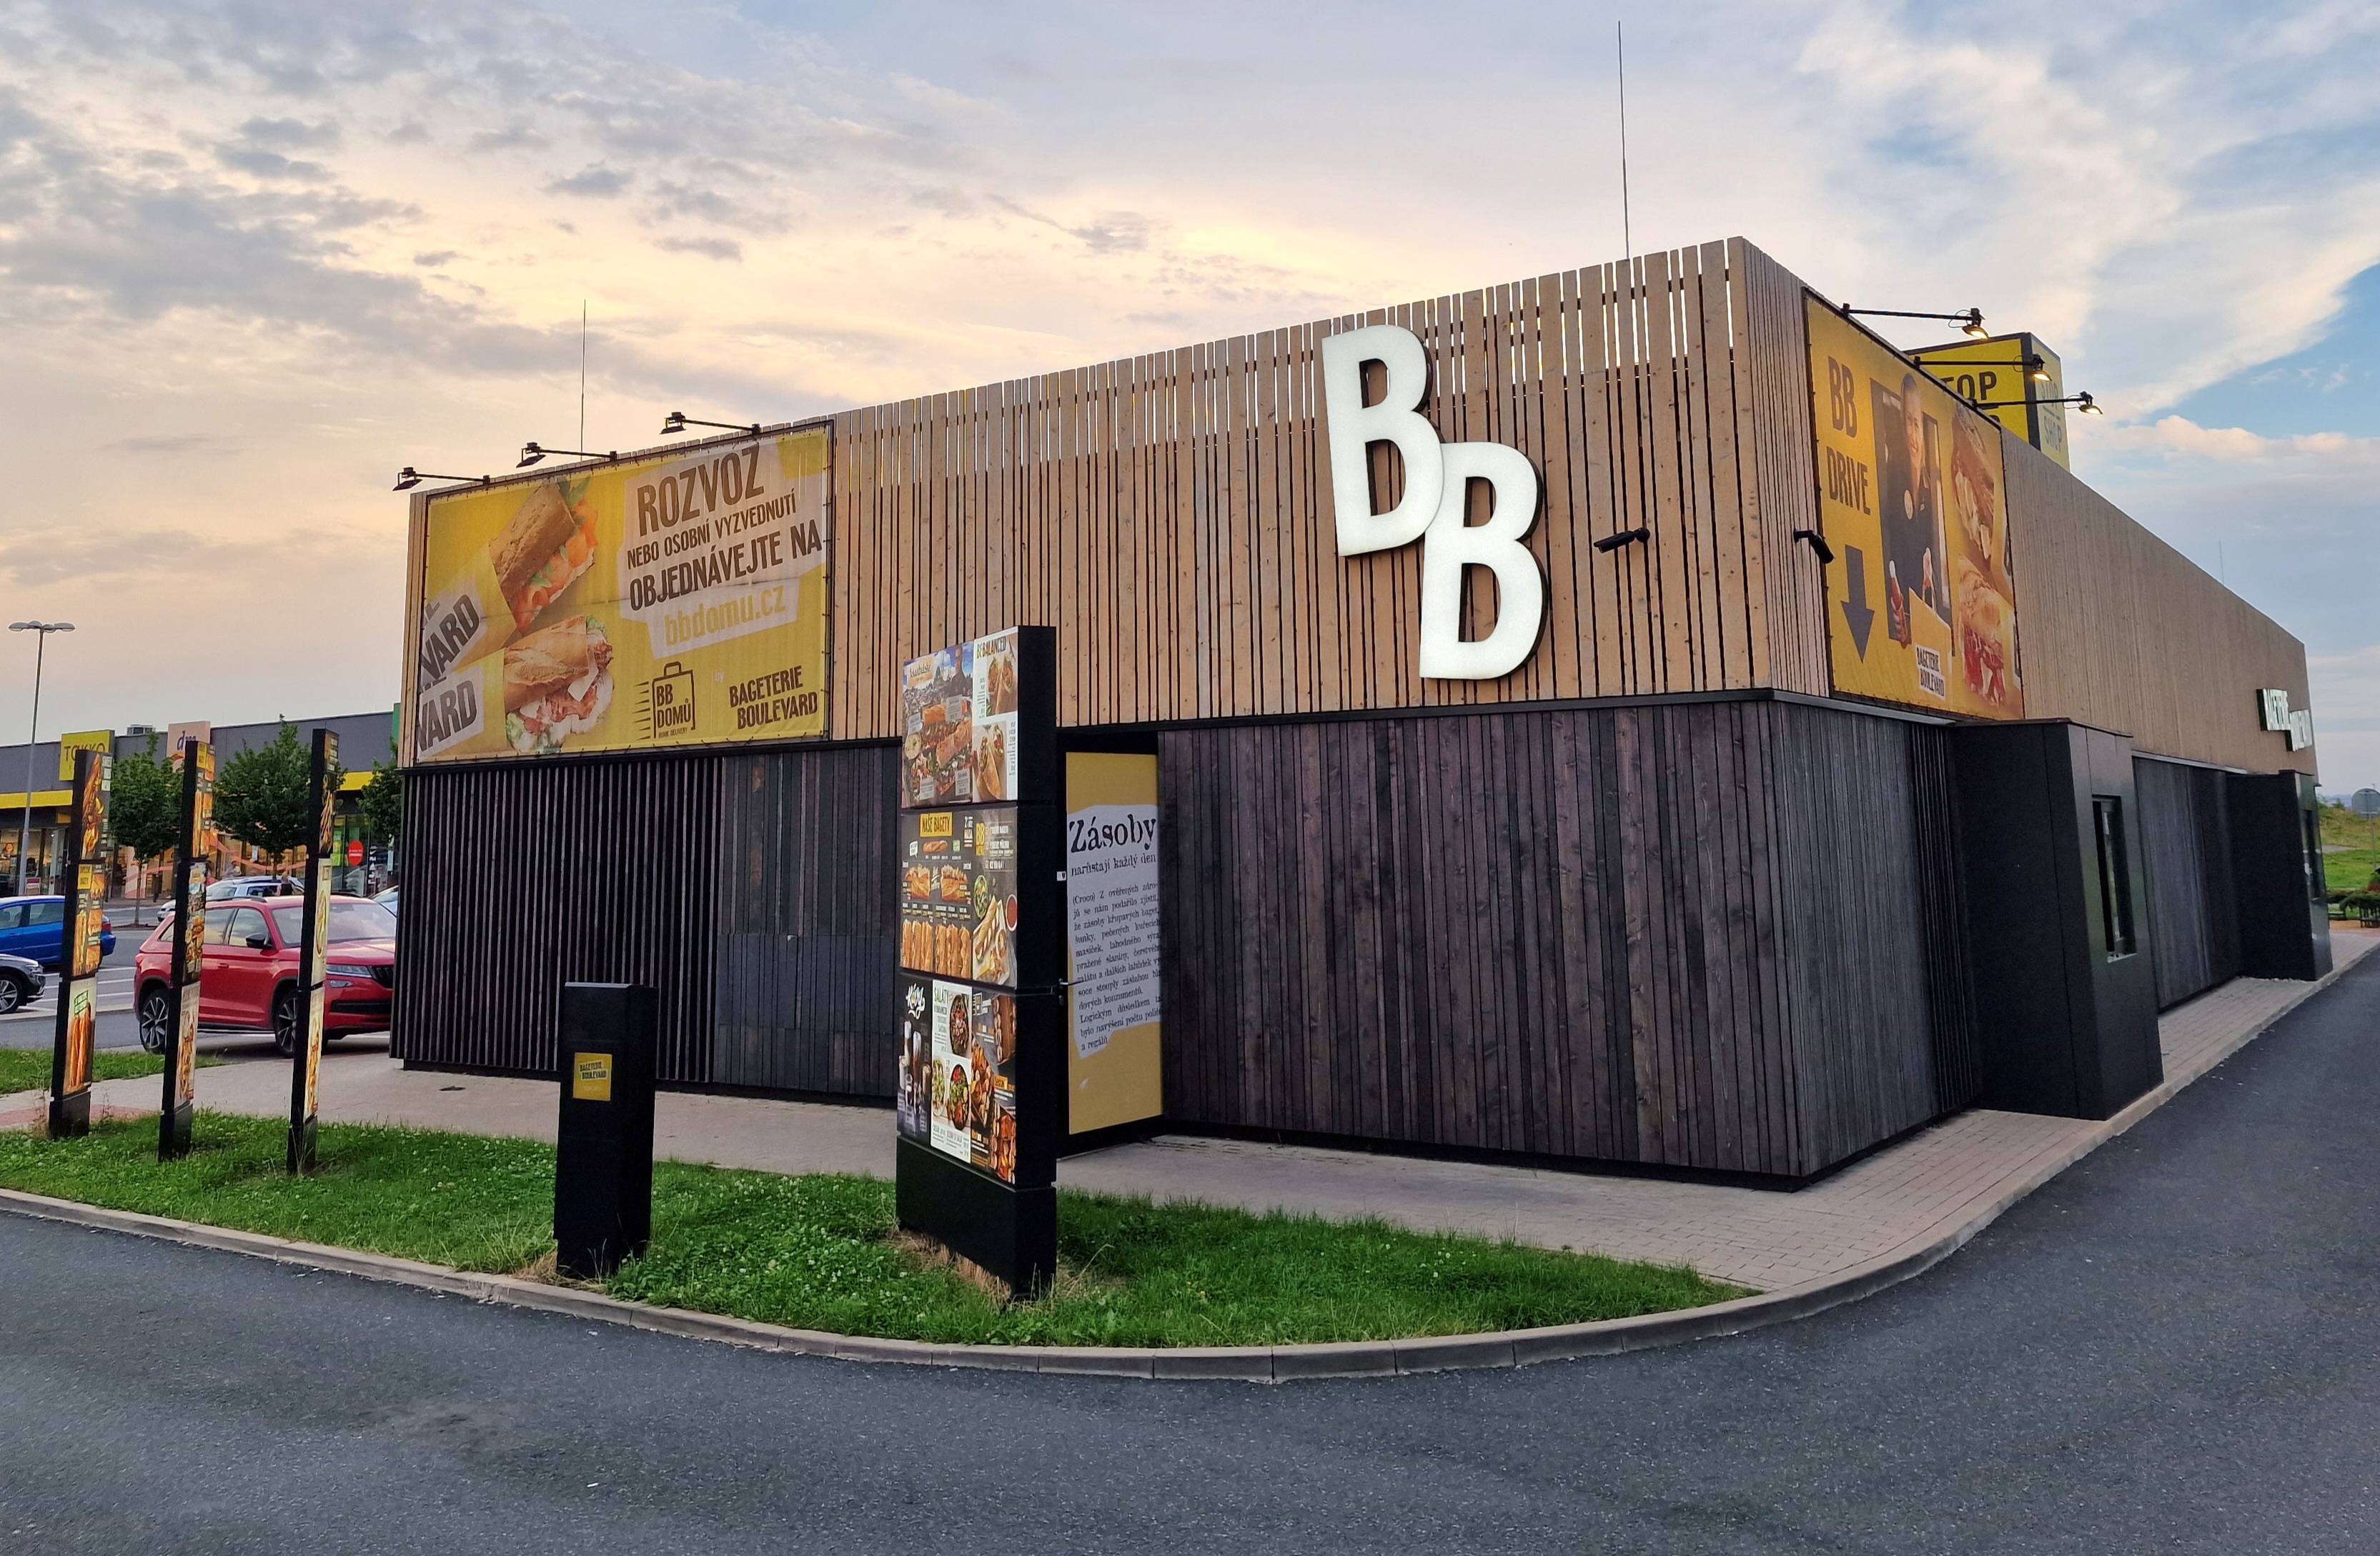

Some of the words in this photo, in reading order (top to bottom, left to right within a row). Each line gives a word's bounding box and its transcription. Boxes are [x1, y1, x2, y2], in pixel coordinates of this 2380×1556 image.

[1828, 355, 1858, 438] BB
[637, 443, 764, 537] ROZVOZ
[1826, 445, 1871, 516] DRIVE
[628, 541, 660, 570] NEBO
[664, 519, 710, 557] OSOBNÍ
[715, 487, 796, 539] VYZVEDNUTÍ
[630, 531, 783, 612] OBJEDNÁVEJTE
[790, 519, 823, 559] NA
[664, 585, 785, 646] bbdomu.cz
[657, 683, 673, 708] BB
[729, 665, 803, 708] BAGETERIE
[658, 698, 690, 728] DOMŮ
[737, 692, 818, 730] BOULEVARD
[1069, 813, 1156, 853] Zásoby
[1071, 858, 1111, 876] narůstají
[1113, 854, 1138, 869] každý
[1141, 853, 1156, 864] den
[1072, 892, 1096, 906] (Croco)
[1109, 884, 1139, 896] ověřených
[1094, 904, 1109, 913] nám
[1112, 898, 1137, 911] podařilo
[1084, 917, 1105, 928] zásoby
[1101, 924, 1130, 941] pečených
[1109, 936, 1141, 949] lahodného
[1076, 956, 1101, 973] pražené
[1104, 964, 1126, 977] dalších
[1078, 988, 1092, 996] soce
[1096, 979, 1119, 992] stouply
[1122, 972, 1149, 986] zásluhou
[1079, 997, 1101, 1010] dových
[1080, 1009, 1112, 1024] Logickým
[1117, 998, 1150, 1014] důsledkem
[1081, 1026, 1094, 1039] bylo
[1096, 1017, 1124, 1031] navýšení
[1126, 1014, 1143, 1027] počtu
